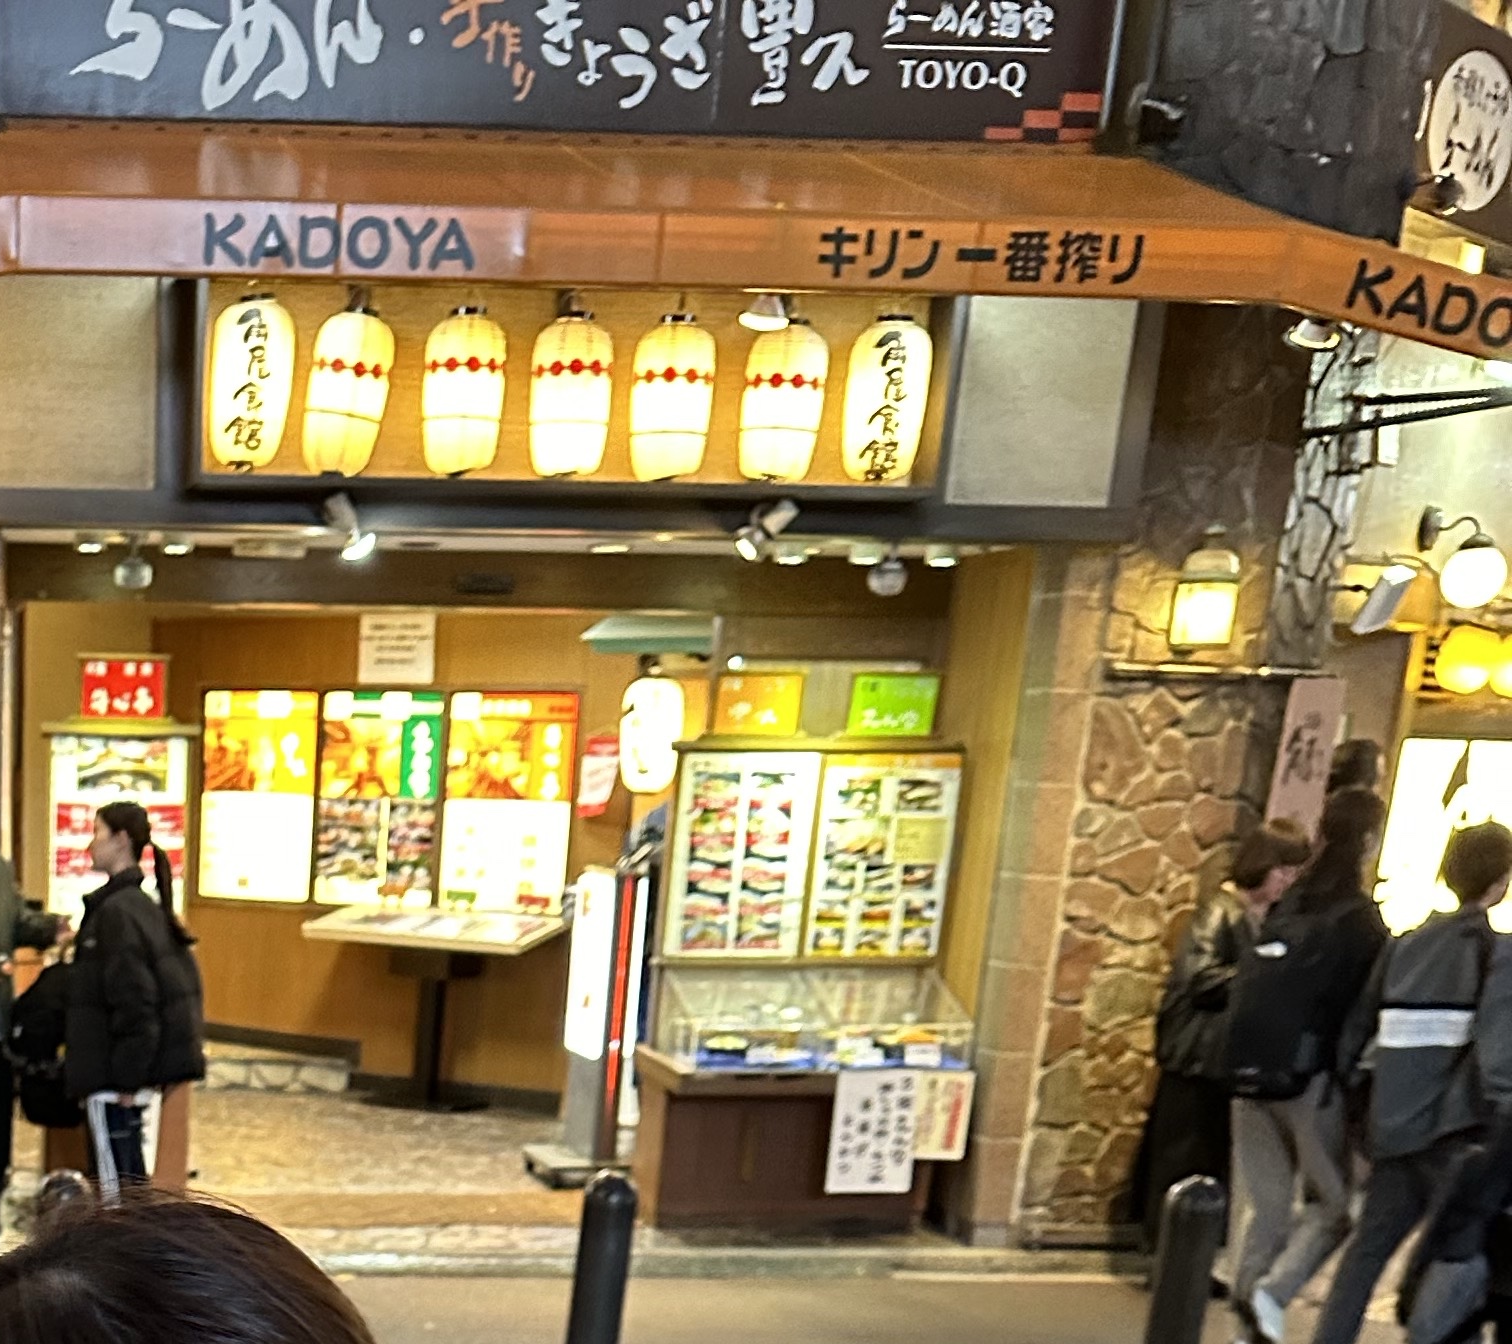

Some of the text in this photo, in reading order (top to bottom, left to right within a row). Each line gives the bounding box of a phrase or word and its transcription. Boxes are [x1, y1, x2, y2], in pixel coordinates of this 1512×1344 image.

[897, 58, 1028, 98] TOYO-Q
[202, 210, 476, 272] KADOYA
[817, 225, 1146, 285] キリン一番搾り
